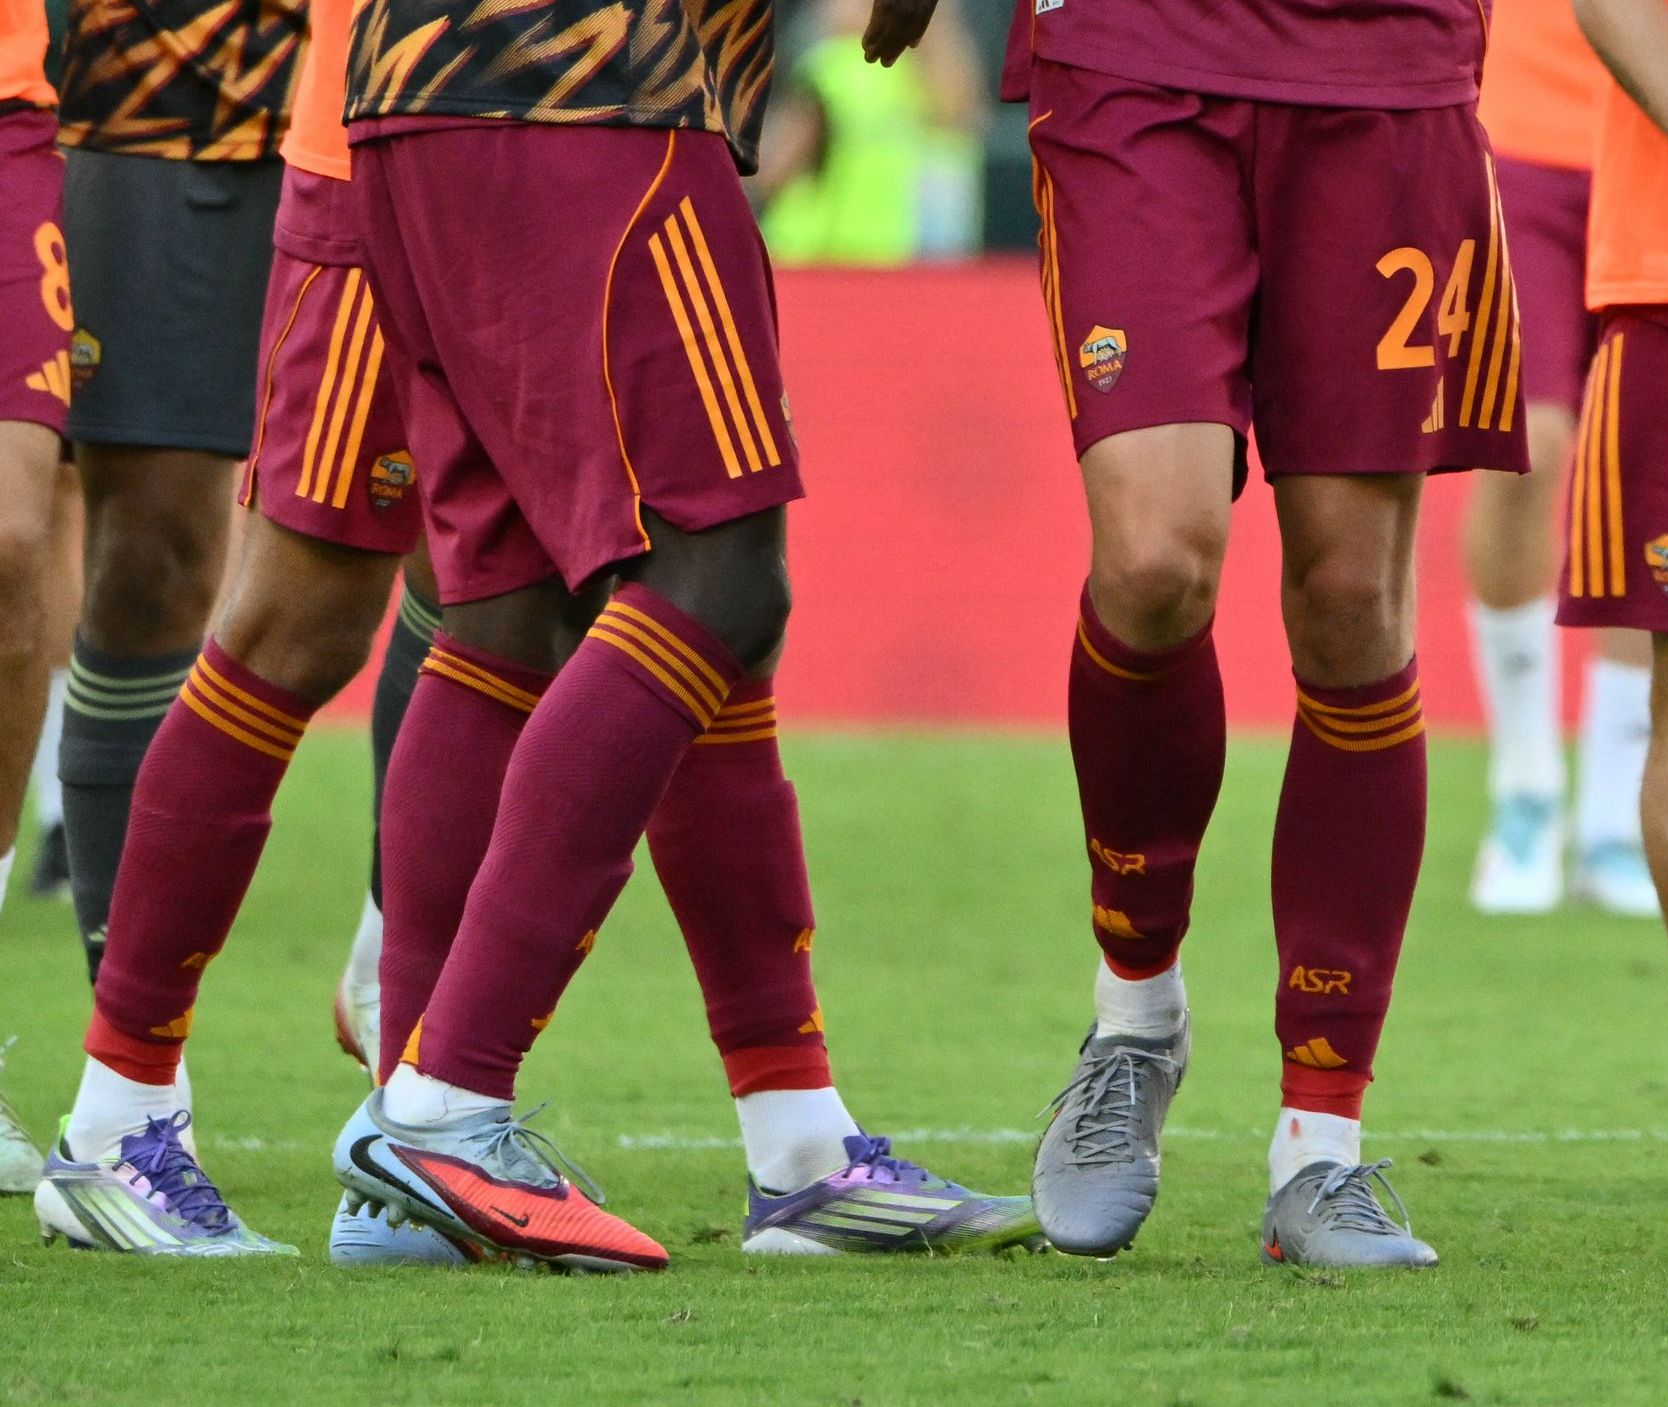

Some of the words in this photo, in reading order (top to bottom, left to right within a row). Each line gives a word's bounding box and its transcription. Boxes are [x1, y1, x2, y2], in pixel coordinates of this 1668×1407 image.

[1375, 238, 1476, 371] 24
[1087, 359, 1123, 381] ROMA
[1288, 964, 1352, 995] ASR
